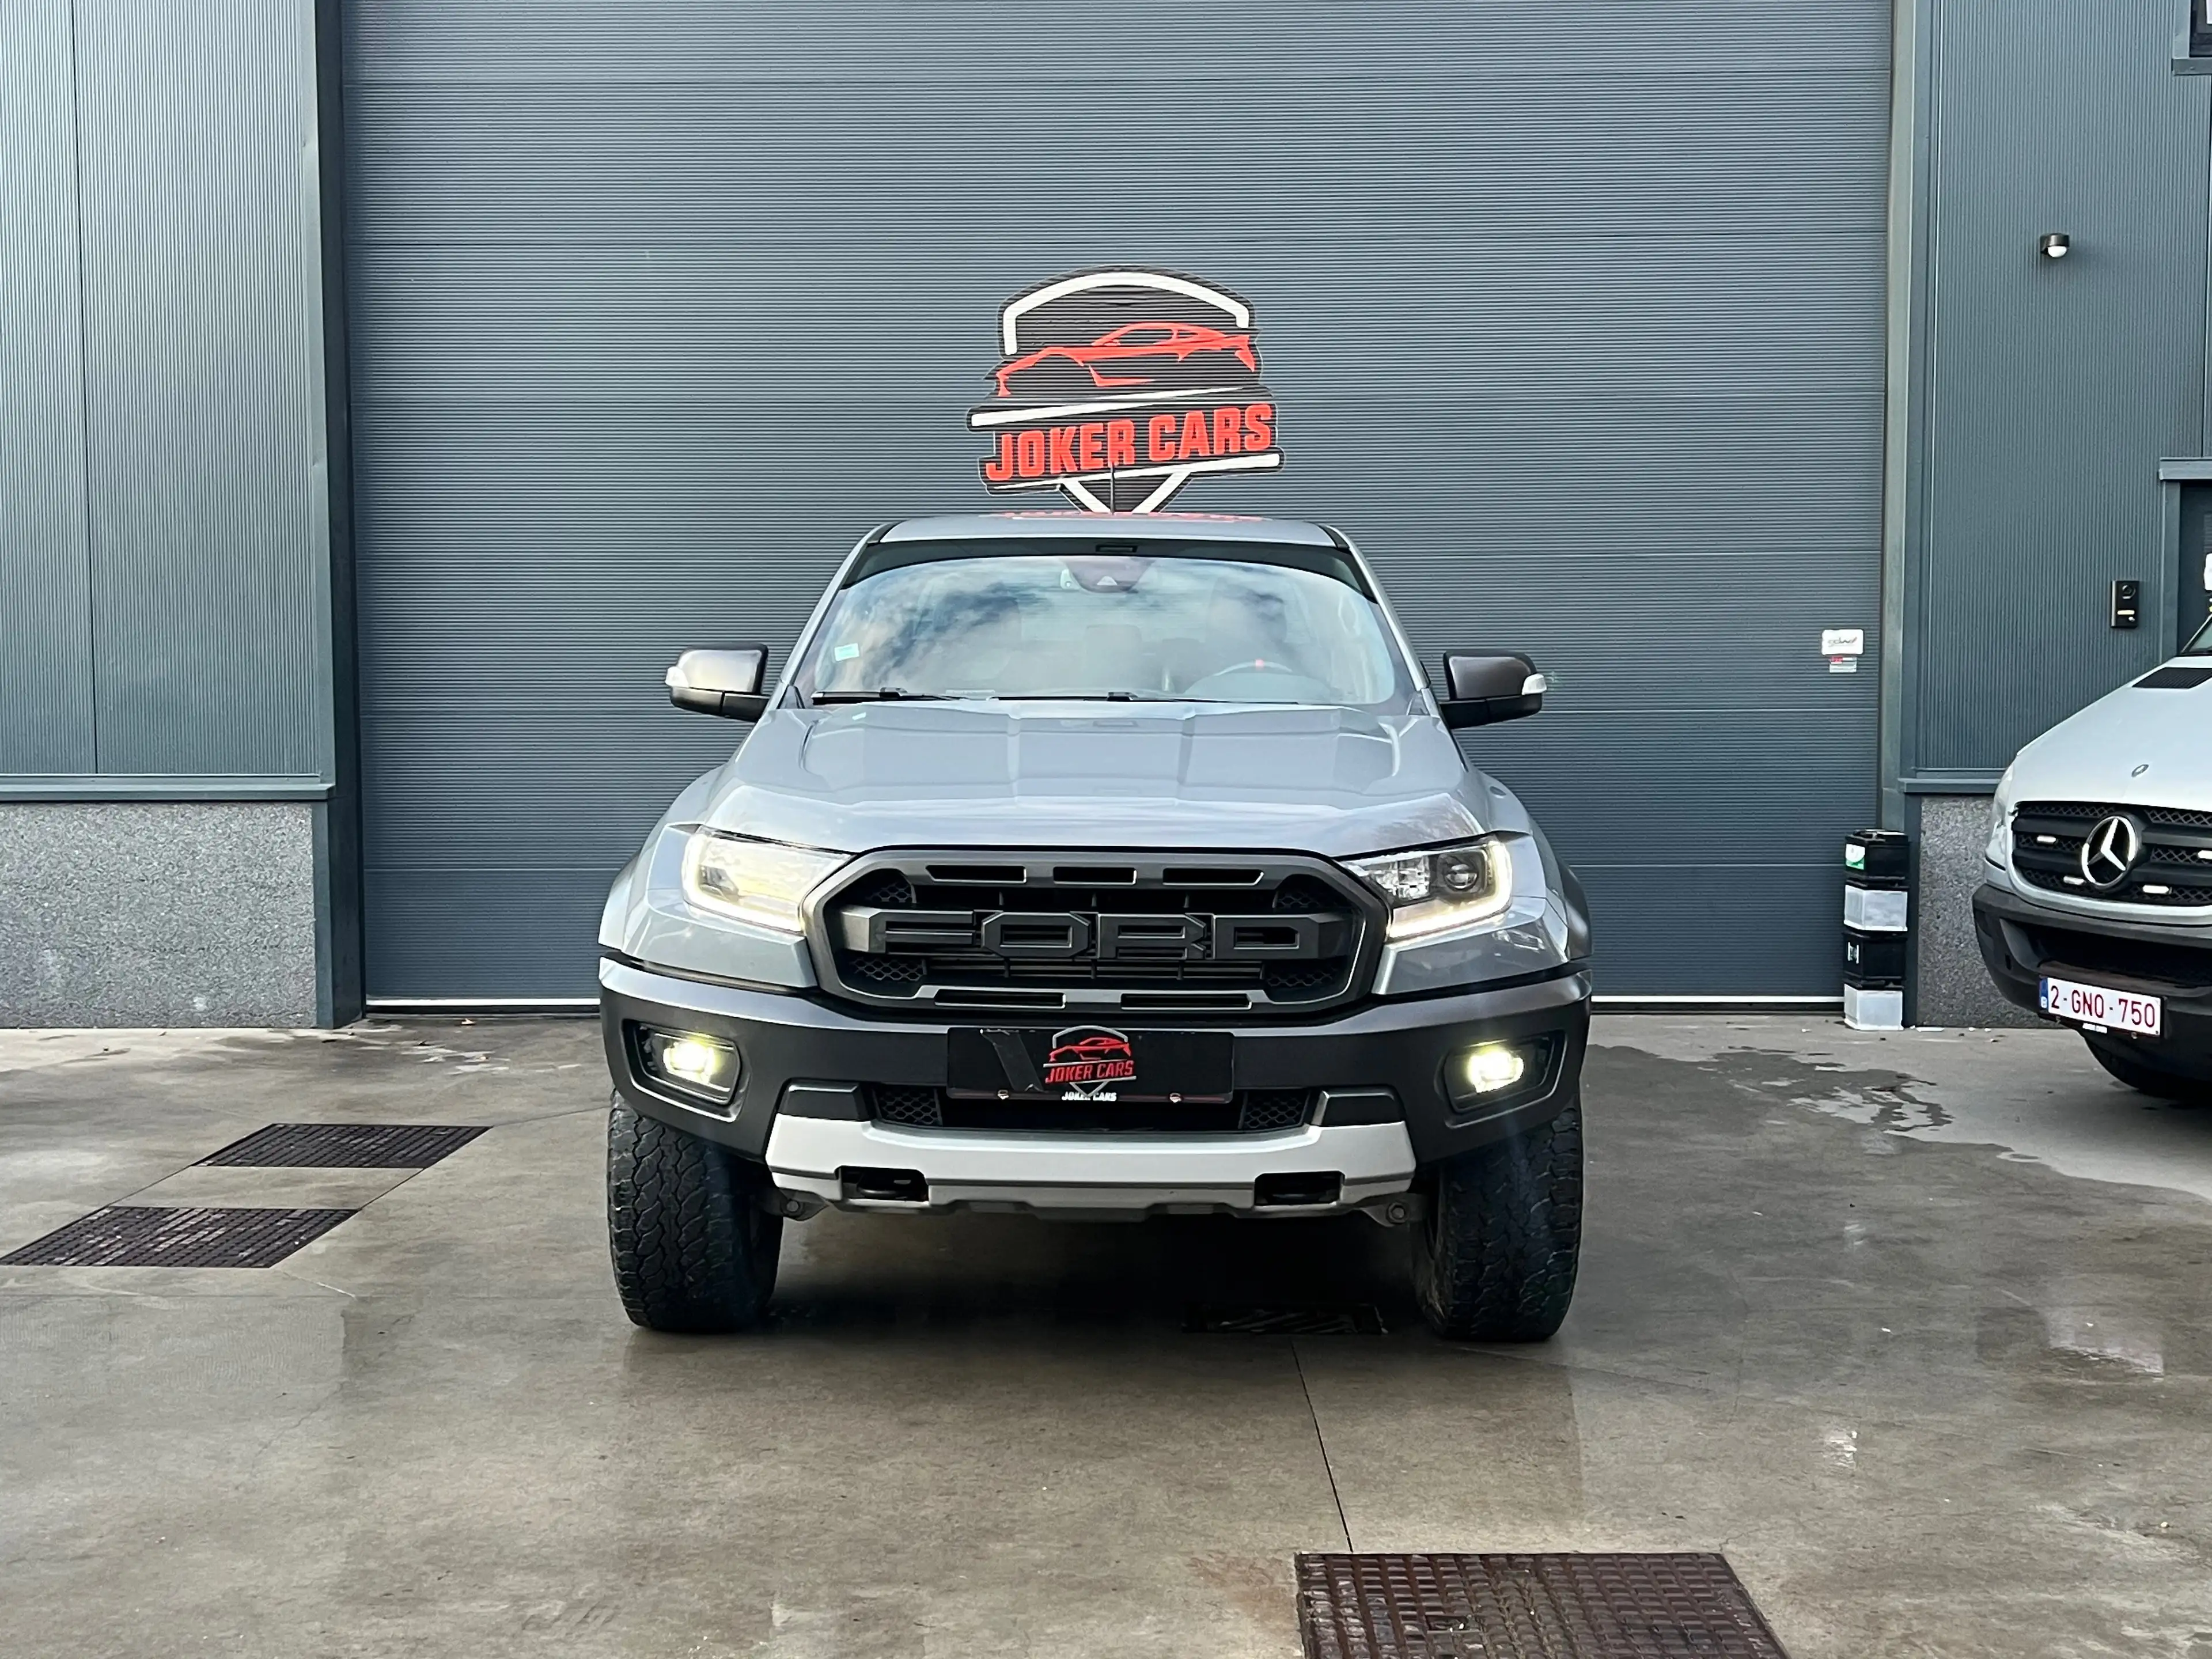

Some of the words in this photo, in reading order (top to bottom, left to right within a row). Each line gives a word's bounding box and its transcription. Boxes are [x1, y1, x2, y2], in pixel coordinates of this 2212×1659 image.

[986, 419, 1135, 481] JOKER
[1149, 403, 1272, 461] CARS
[841, 908, 1352, 960] FORD
[1045, 1064, 1094, 1084] JOKER
[1097, 1060, 1135, 1078] CARS
